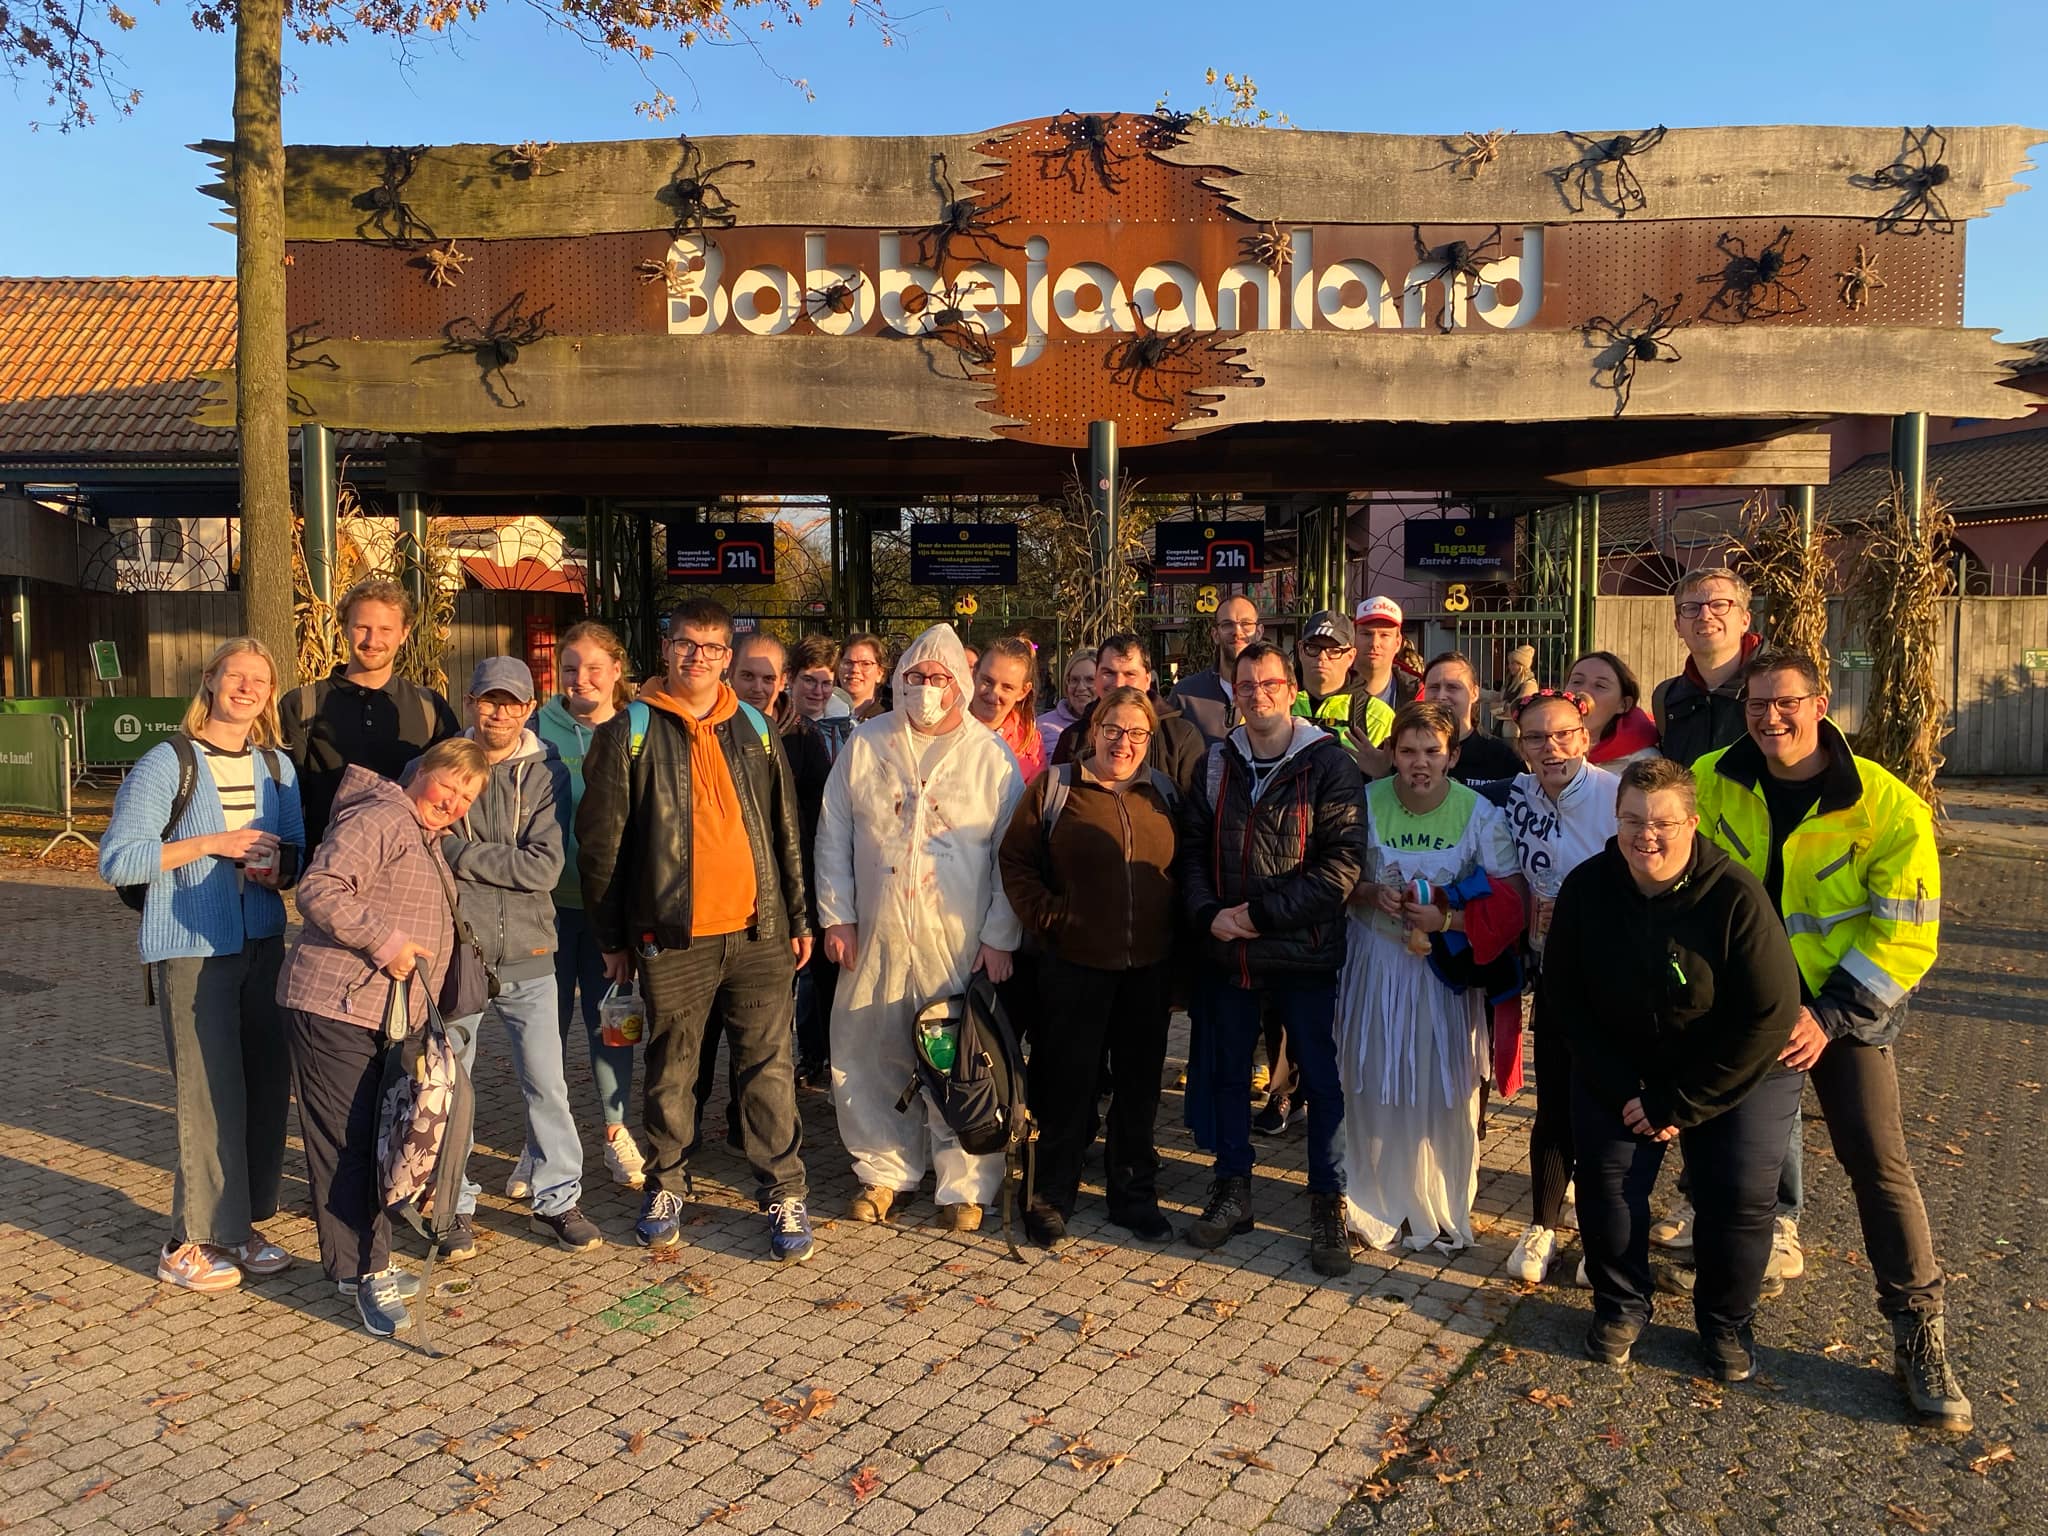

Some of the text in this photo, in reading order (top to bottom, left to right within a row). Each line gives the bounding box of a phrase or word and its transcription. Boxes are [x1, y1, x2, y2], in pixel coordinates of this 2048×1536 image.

[667, 226, 1545, 368] Bobbejaanland
[1434, 543, 1487, 556] Ingang
[727, 550, 757, 568] 21h
[1215, 549, 1245, 567] 21h
[1459, 556, 1502, 566] Eingang
[1363, 601, 1398, 613] Coke
[9, 751, 33, 765] land!
